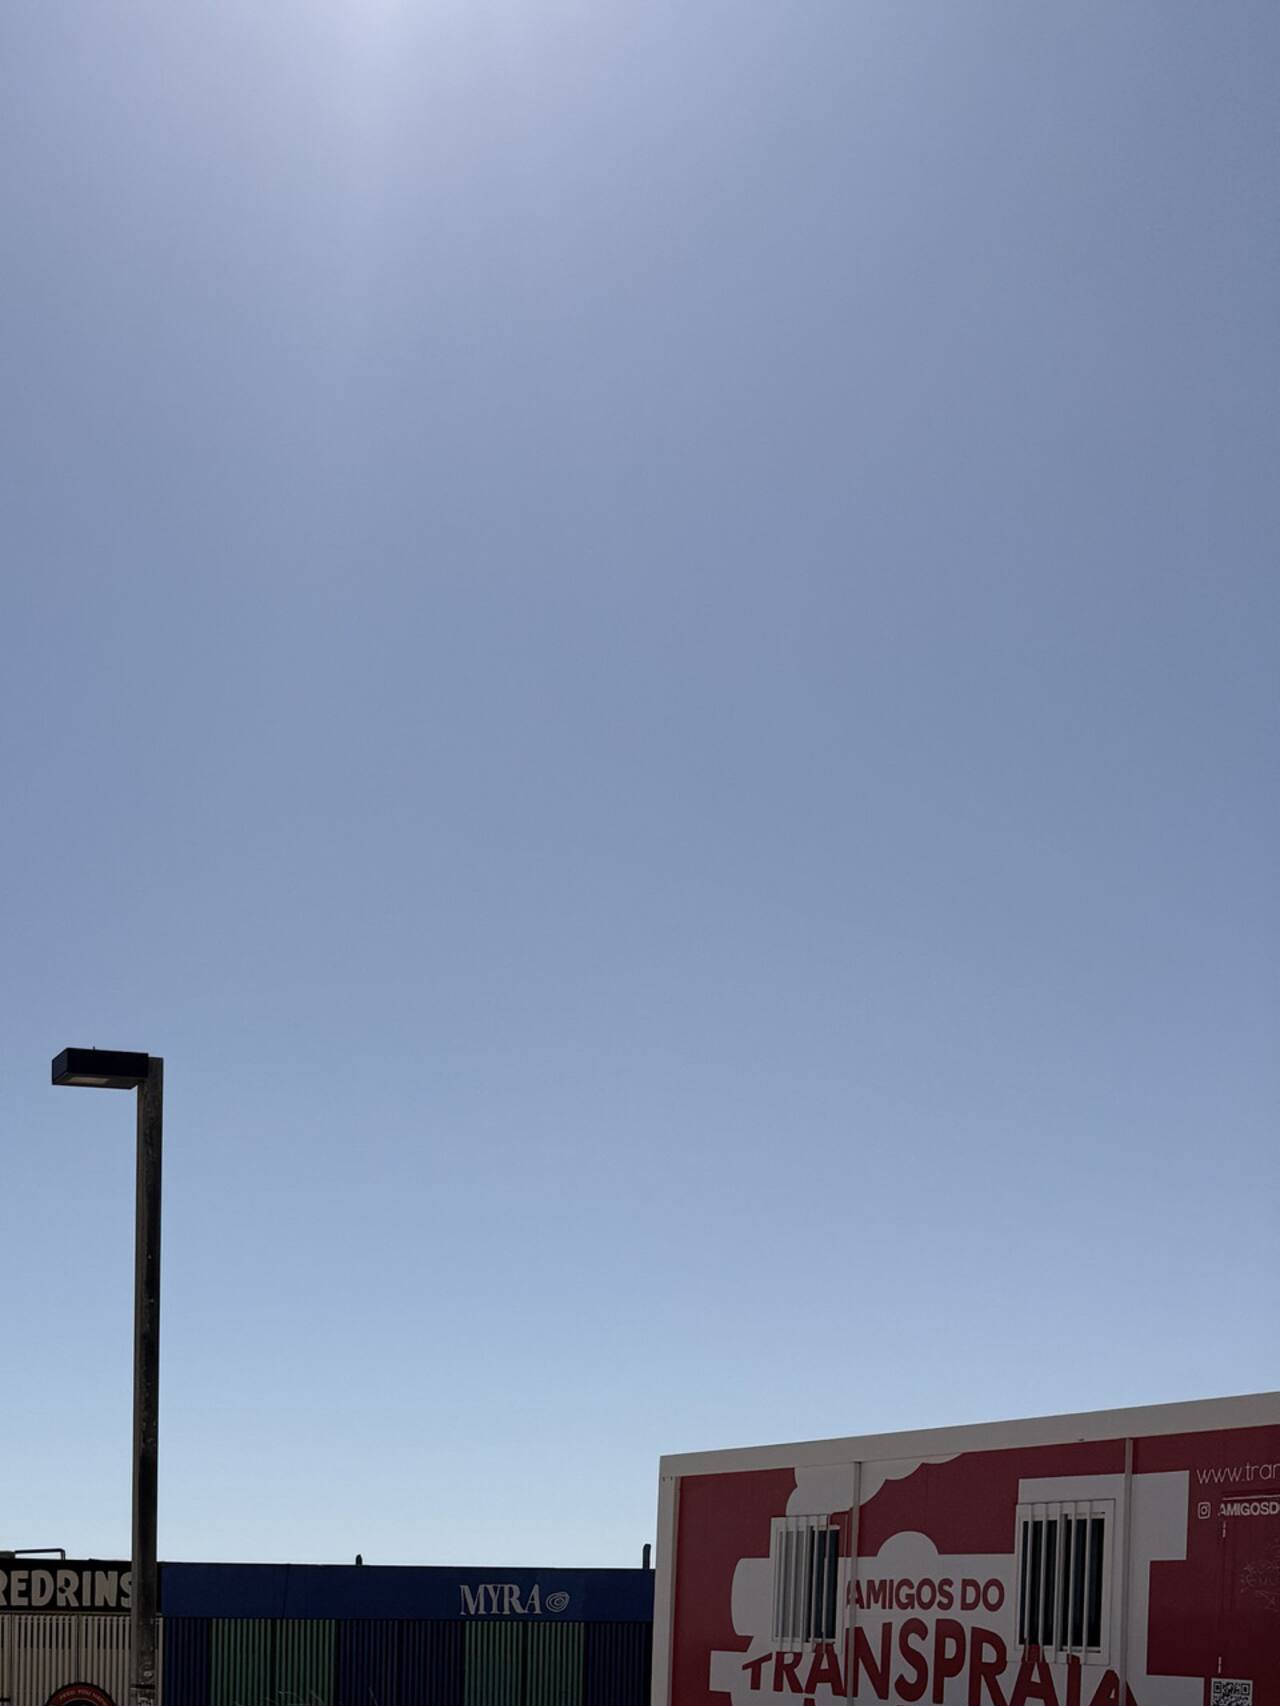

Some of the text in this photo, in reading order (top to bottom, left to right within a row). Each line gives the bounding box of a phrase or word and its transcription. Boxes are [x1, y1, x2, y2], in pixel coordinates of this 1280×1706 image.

[460, 1583, 542, 1615] MYRA
[846, 1577, 1005, 1612] AMIGOS DO
